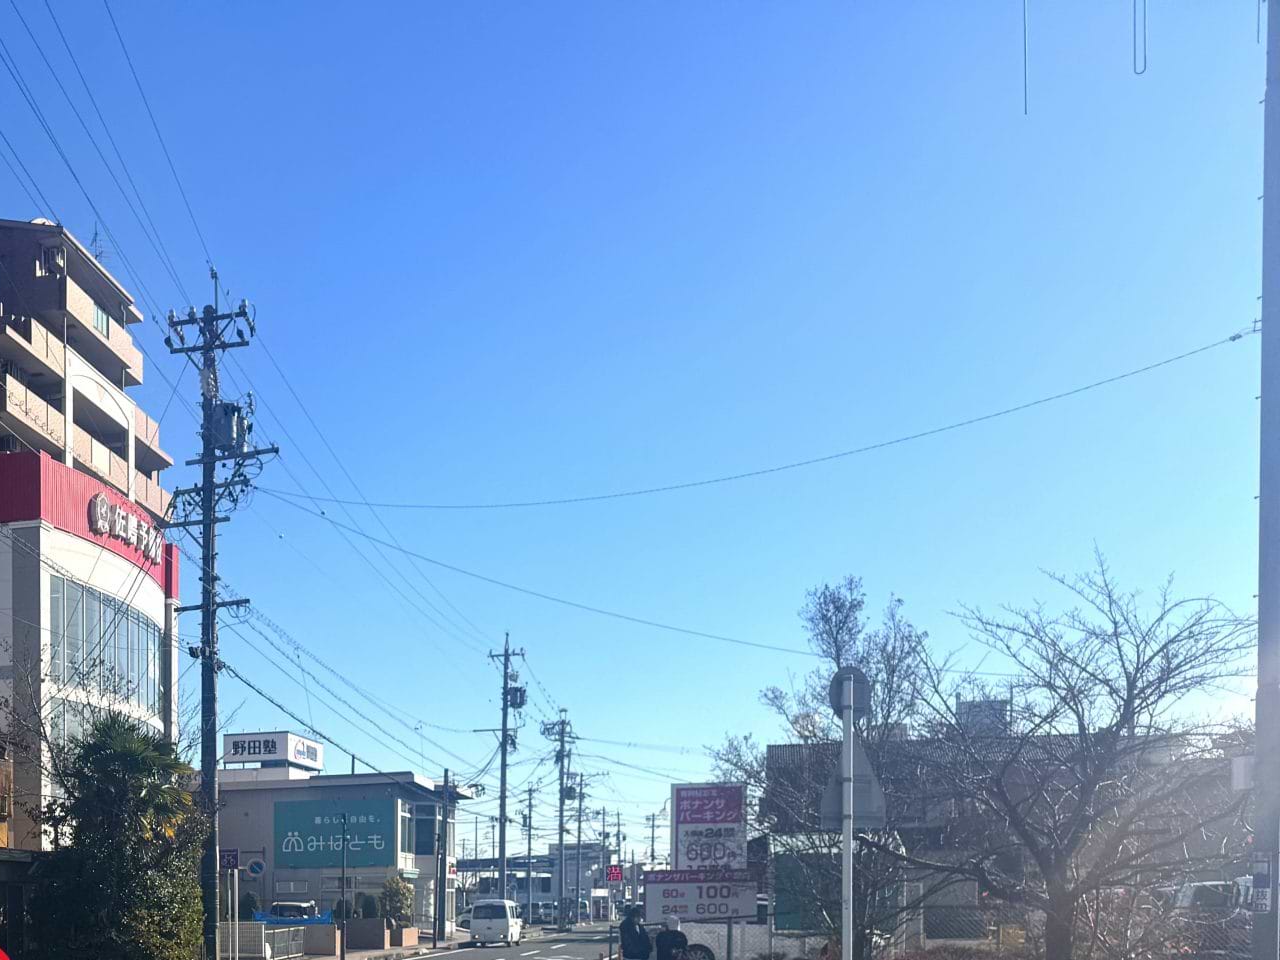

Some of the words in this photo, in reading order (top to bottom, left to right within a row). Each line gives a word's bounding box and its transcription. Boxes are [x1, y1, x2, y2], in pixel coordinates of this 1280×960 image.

[232, 739, 277, 756] 野田塾
[315, 815, 380, 825] 暮らし自由を。
[607, 866, 622, 881] 満
